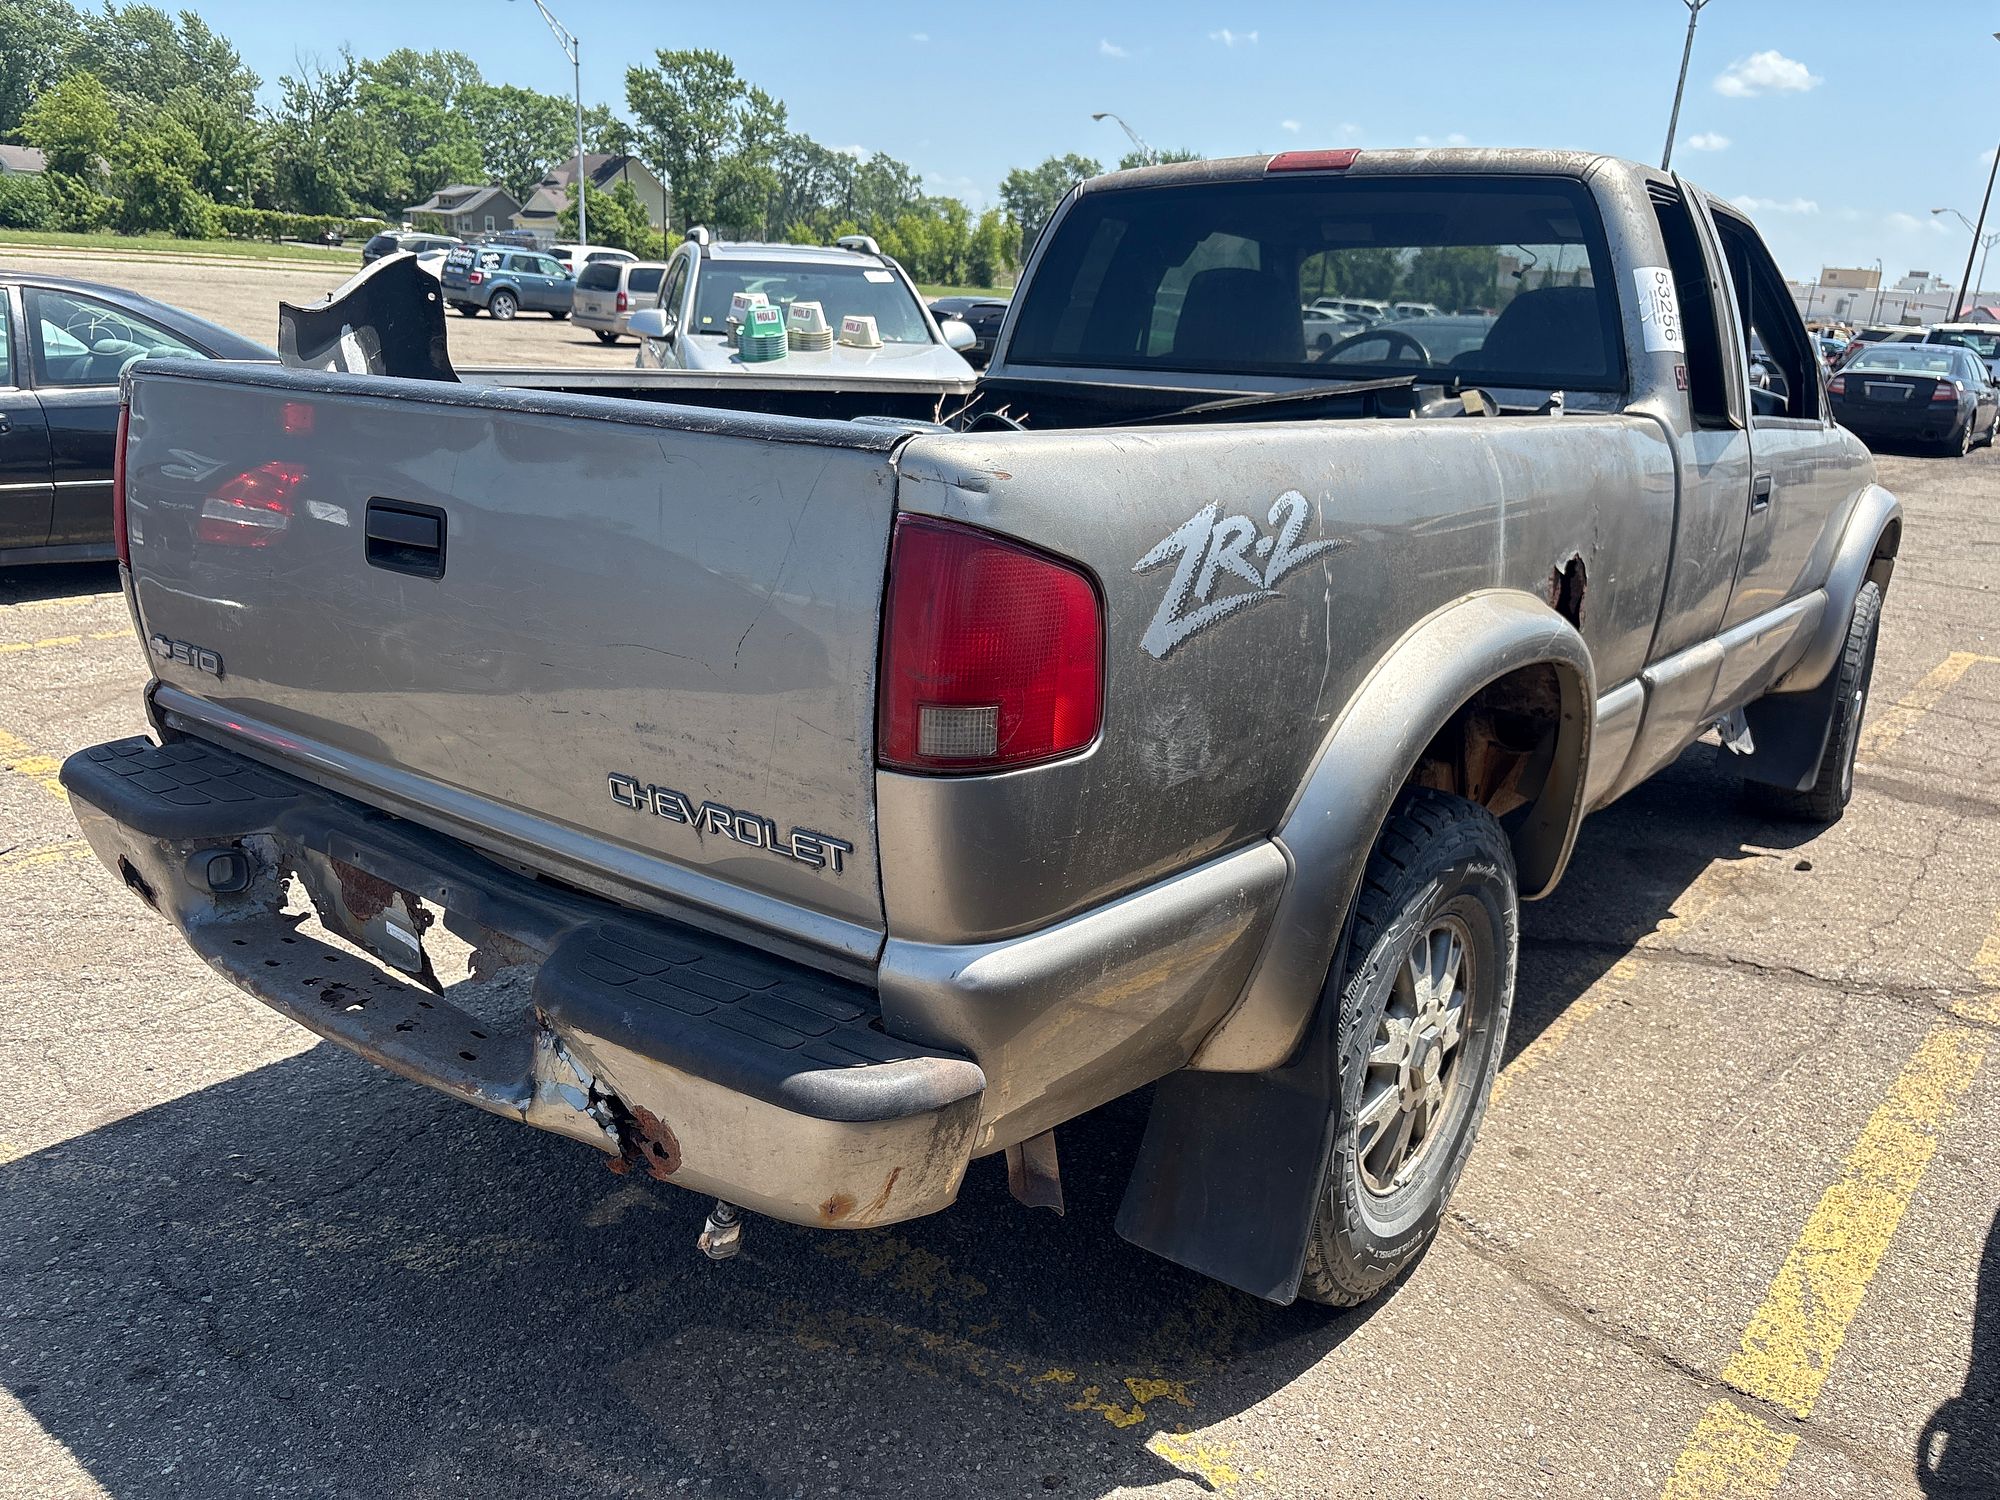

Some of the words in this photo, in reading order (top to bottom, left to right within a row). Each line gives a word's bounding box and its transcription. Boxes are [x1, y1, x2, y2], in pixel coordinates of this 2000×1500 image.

[756, 311, 777, 322] HOLD
[792, 308, 811, 319] HOLD
[1655, 271, 1677, 342] 53256
[845, 322, 861, 332] HOLD
[172, 640, 222, 677] S10
[607, 771, 854, 873] CHEVROLET
